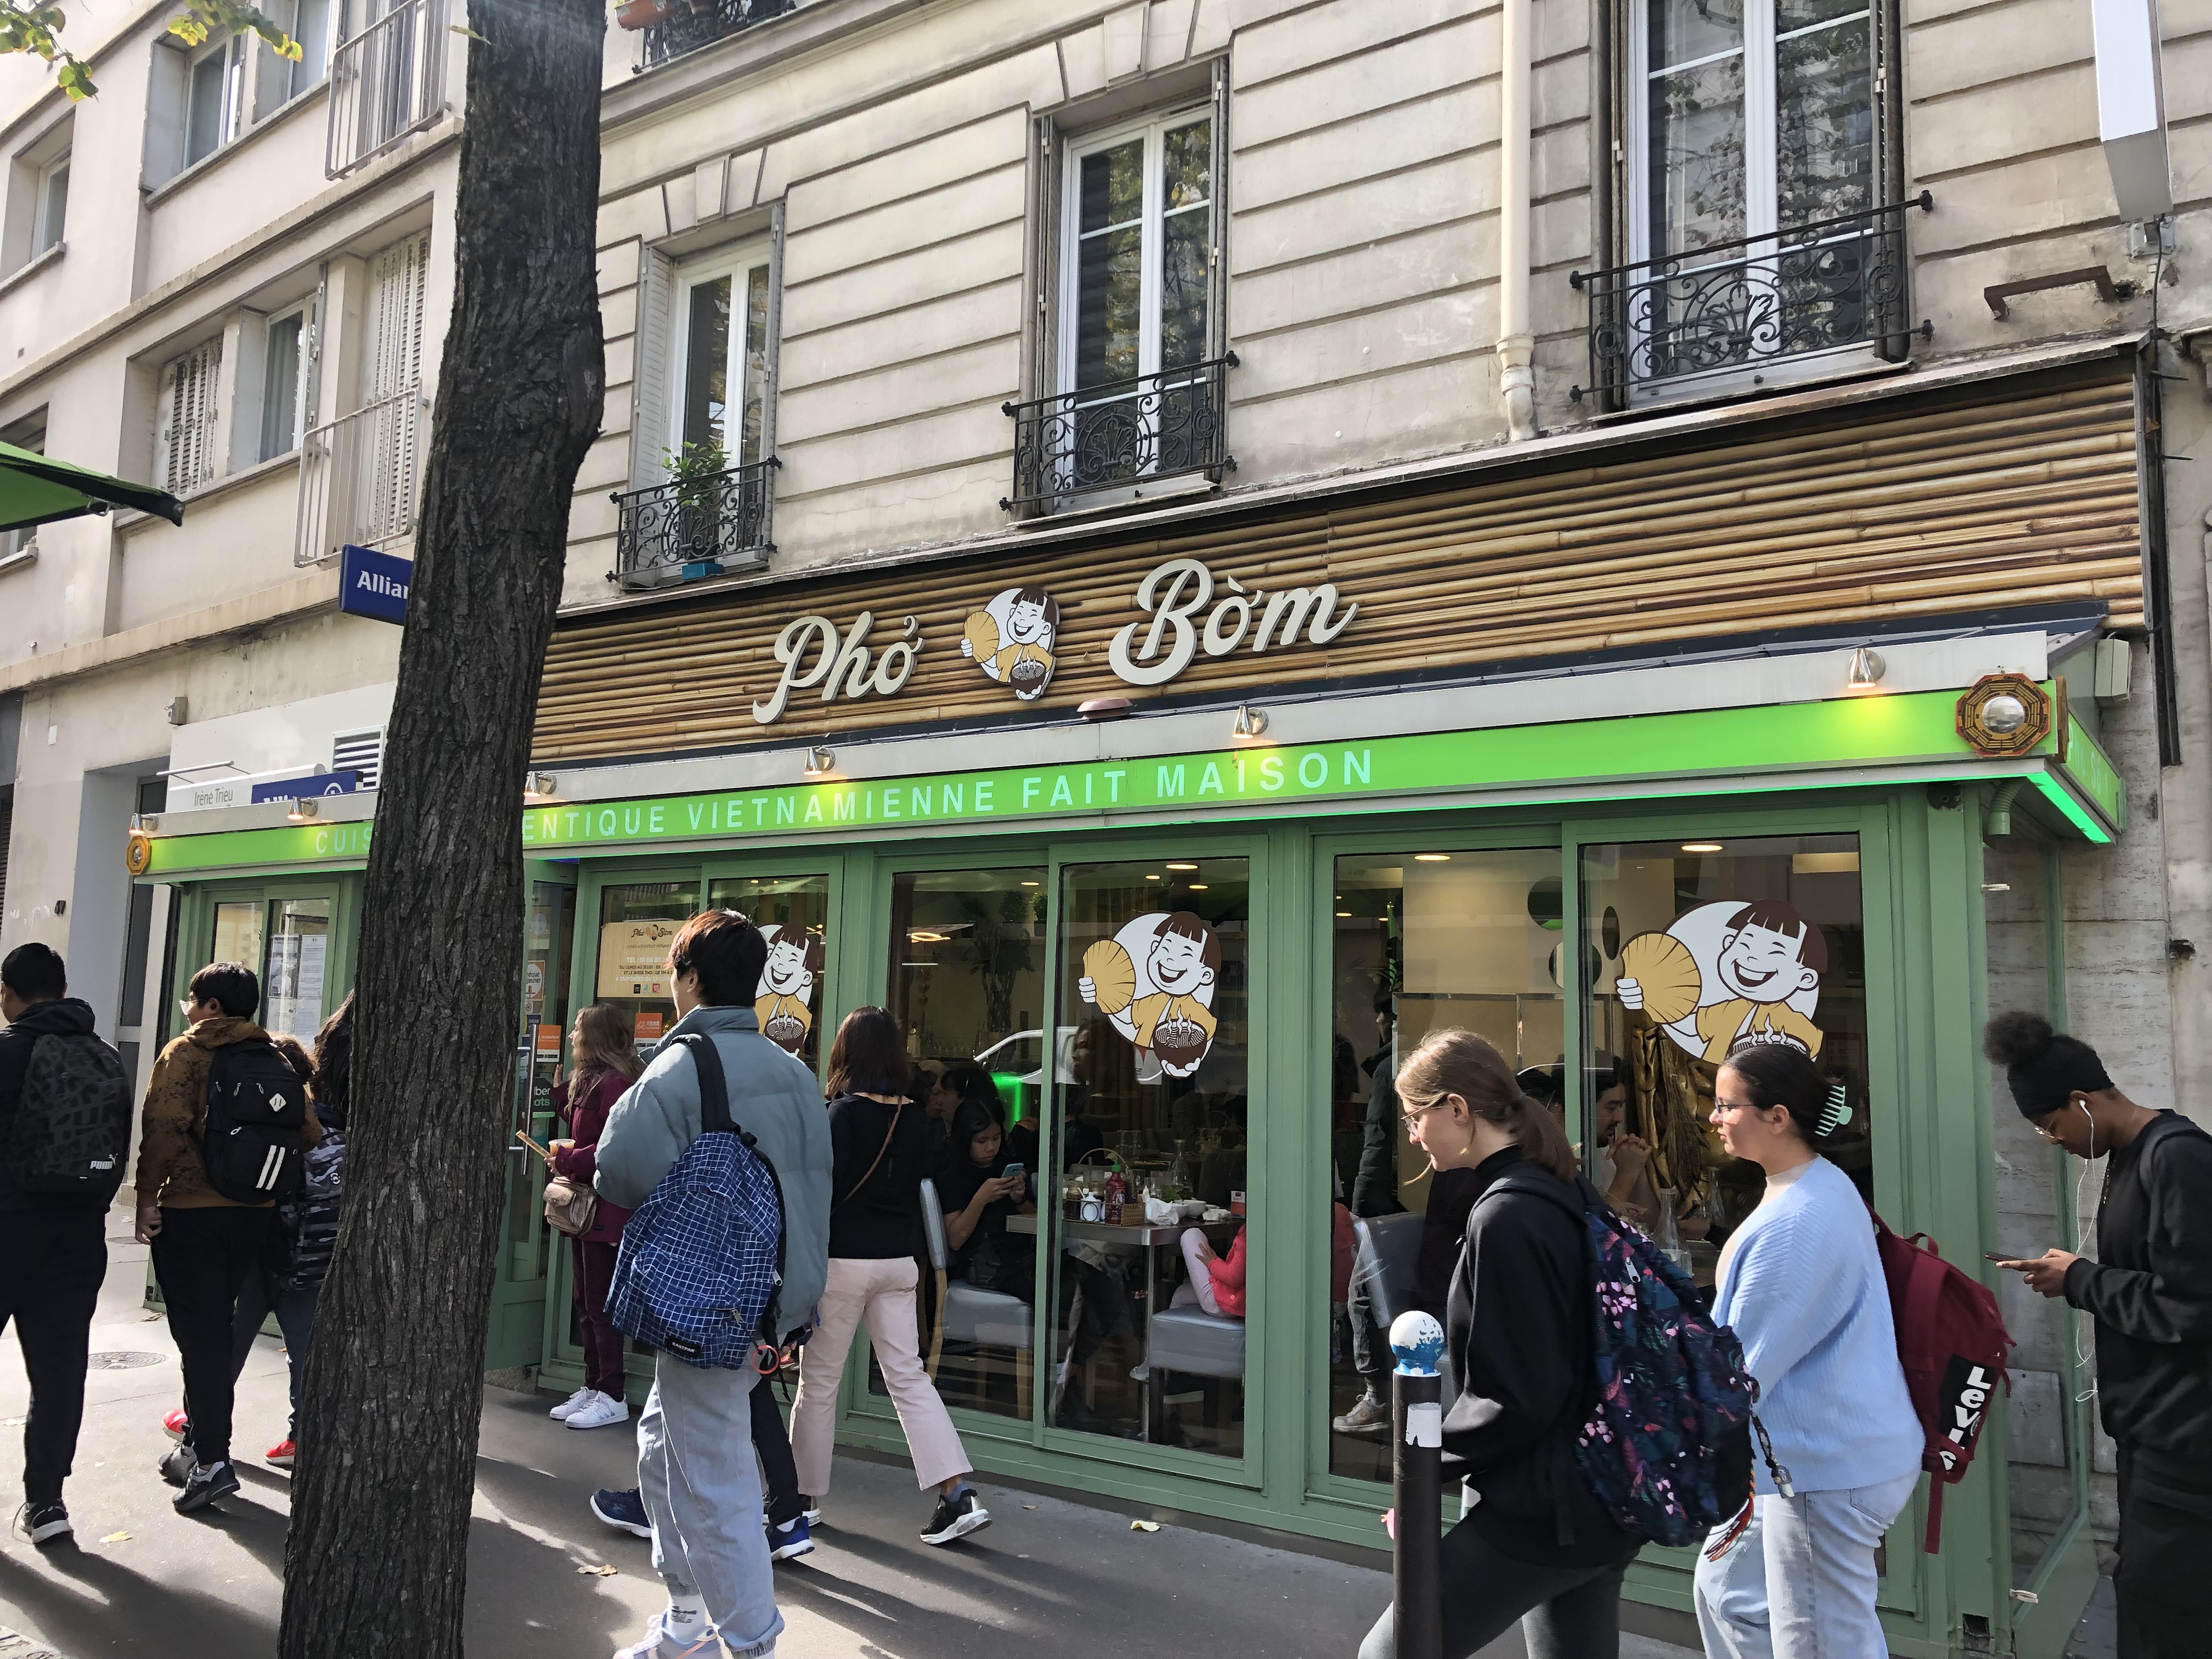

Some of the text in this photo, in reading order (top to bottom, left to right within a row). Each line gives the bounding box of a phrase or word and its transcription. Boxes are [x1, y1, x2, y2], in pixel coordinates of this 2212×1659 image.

[357, 570, 409, 600] Allia
[752, 558, 1359, 725] Phở Bòm
[193, 787, 233, 806] Irène Trieu
[315, 748, 1373, 855] CUIS ENTIQUE VIETNAMIENNE FAIT MAISON
[534, 1097, 550, 1107] ats
[89, 1160, 113, 1170] PUMA
